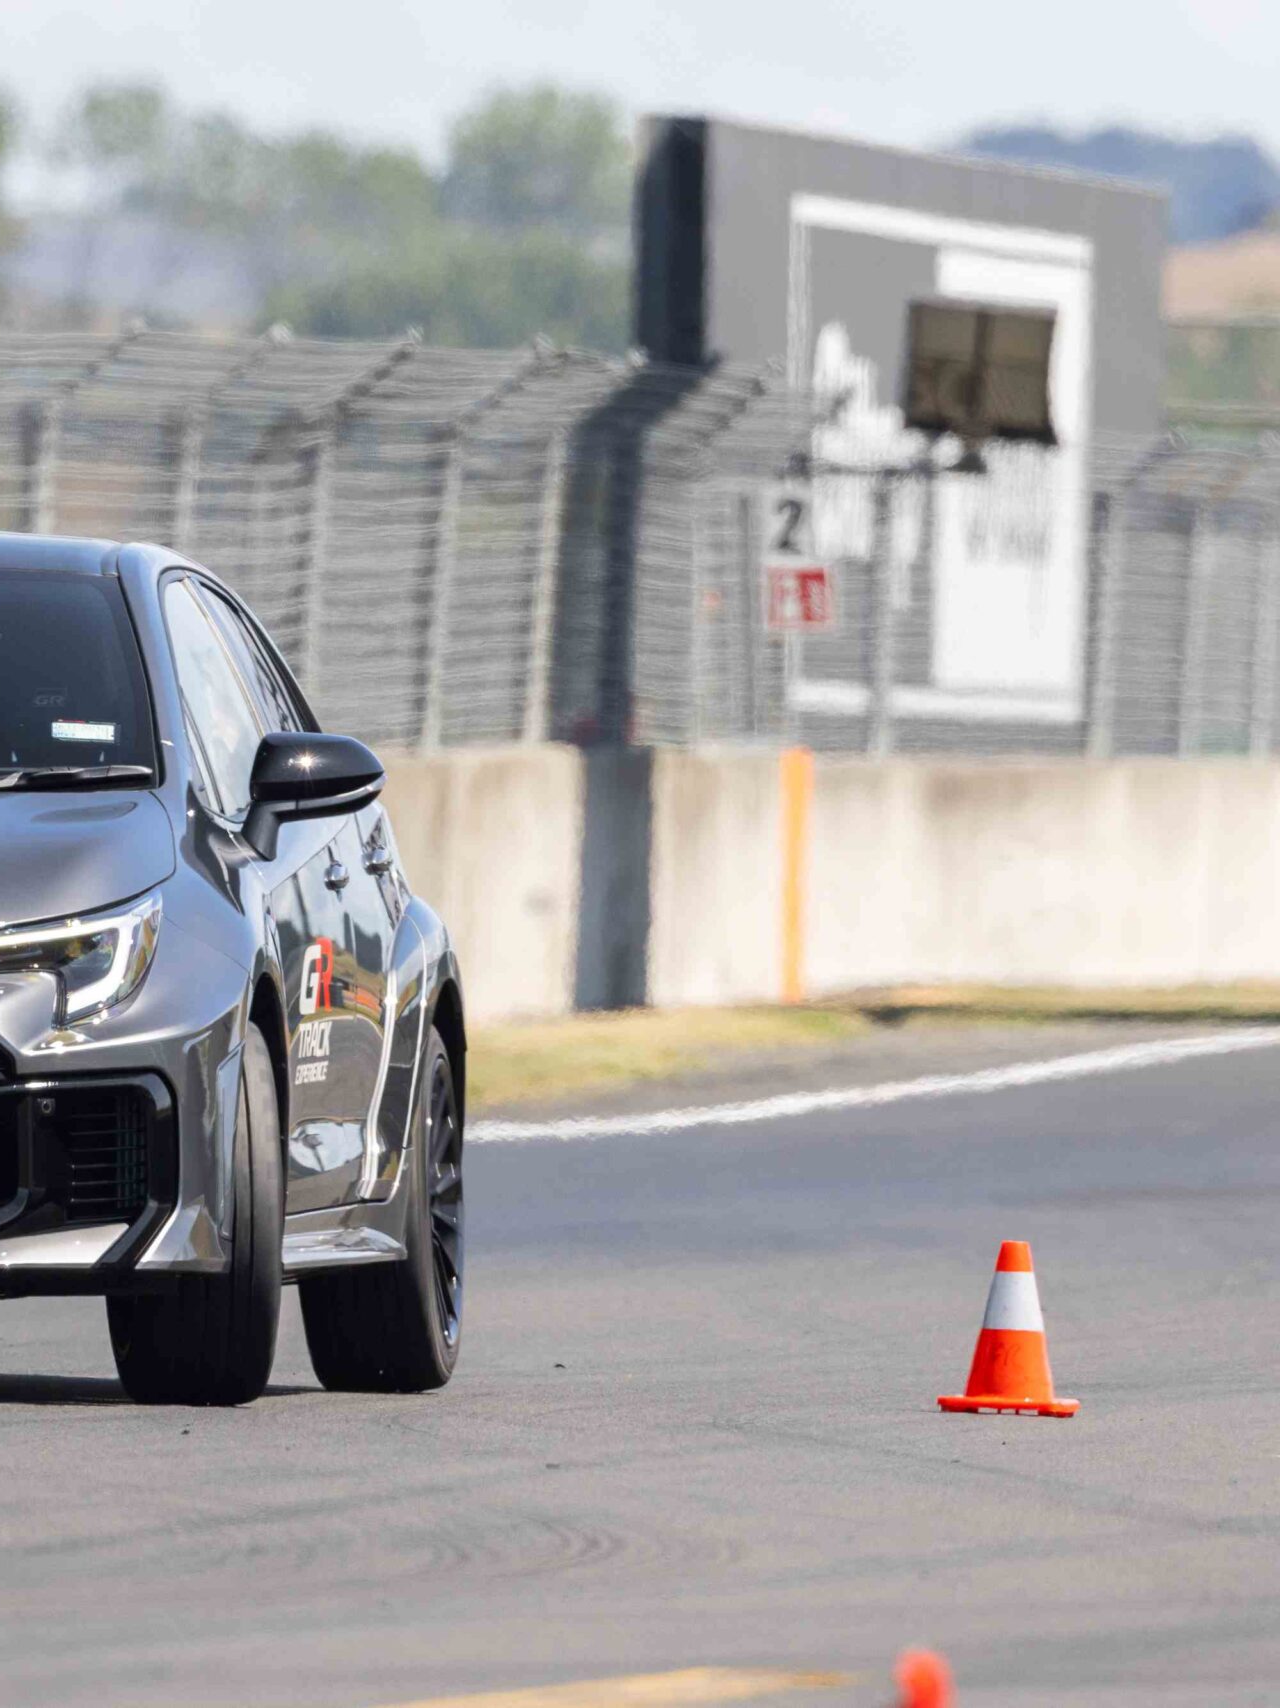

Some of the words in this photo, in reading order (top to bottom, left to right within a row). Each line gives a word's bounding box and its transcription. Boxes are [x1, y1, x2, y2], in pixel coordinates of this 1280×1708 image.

[777, 499, 803, 555] 2
[298, 936, 334, 1015] GR
[298, 1021, 333, 1058] TRACK
